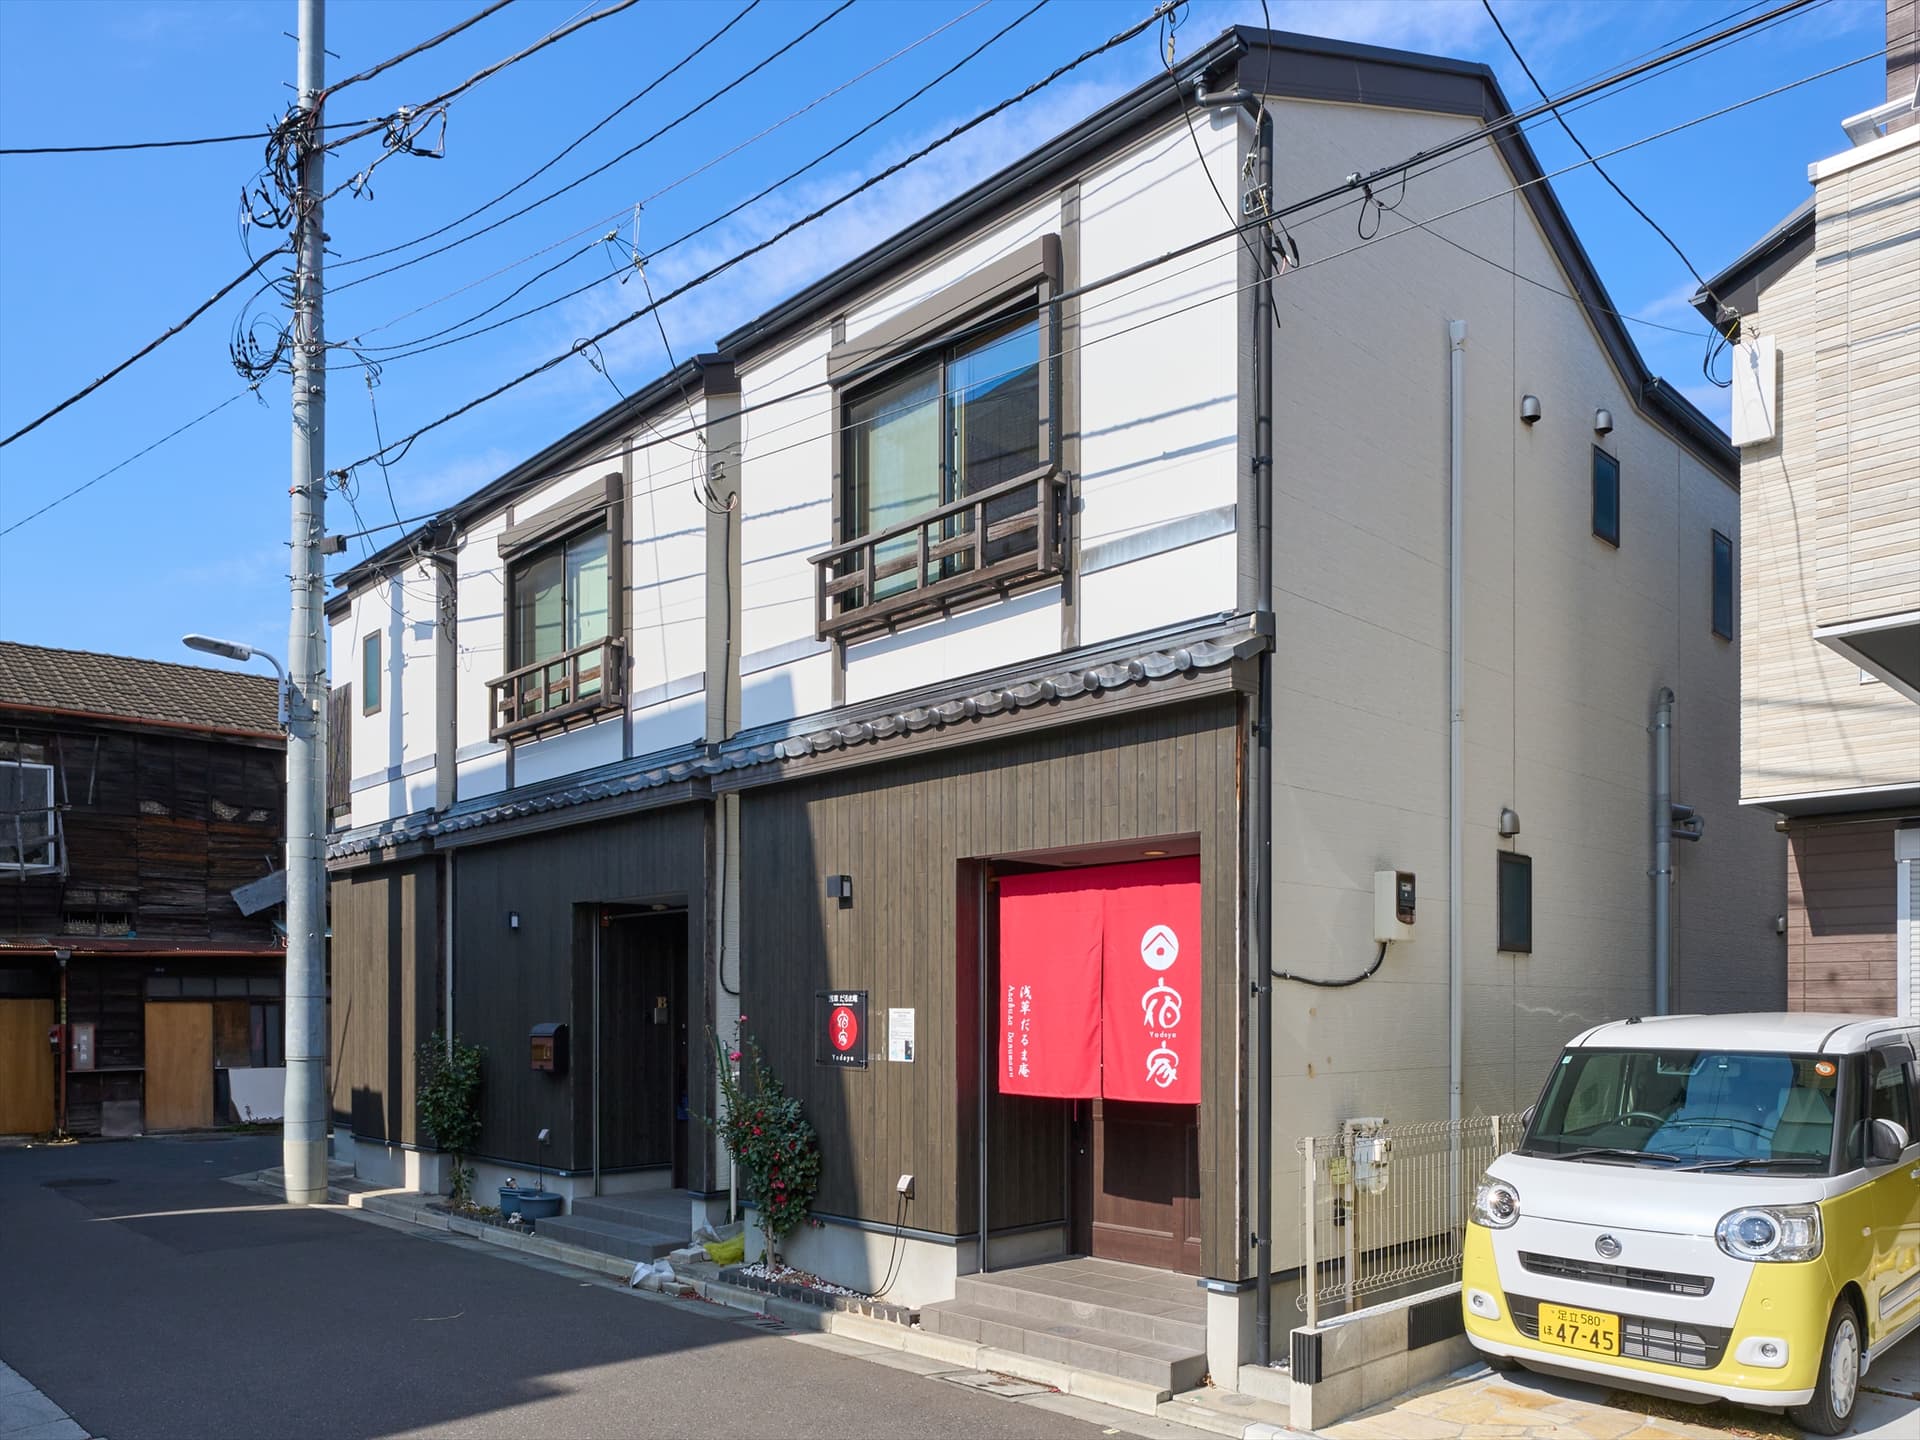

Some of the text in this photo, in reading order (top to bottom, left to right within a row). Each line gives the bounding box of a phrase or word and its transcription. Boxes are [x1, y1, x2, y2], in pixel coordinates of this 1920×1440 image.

[1018, 984, 1032, 1078] 浅草だるま庵
[1543, 1323, 1614, 1351] ほ 47-45
